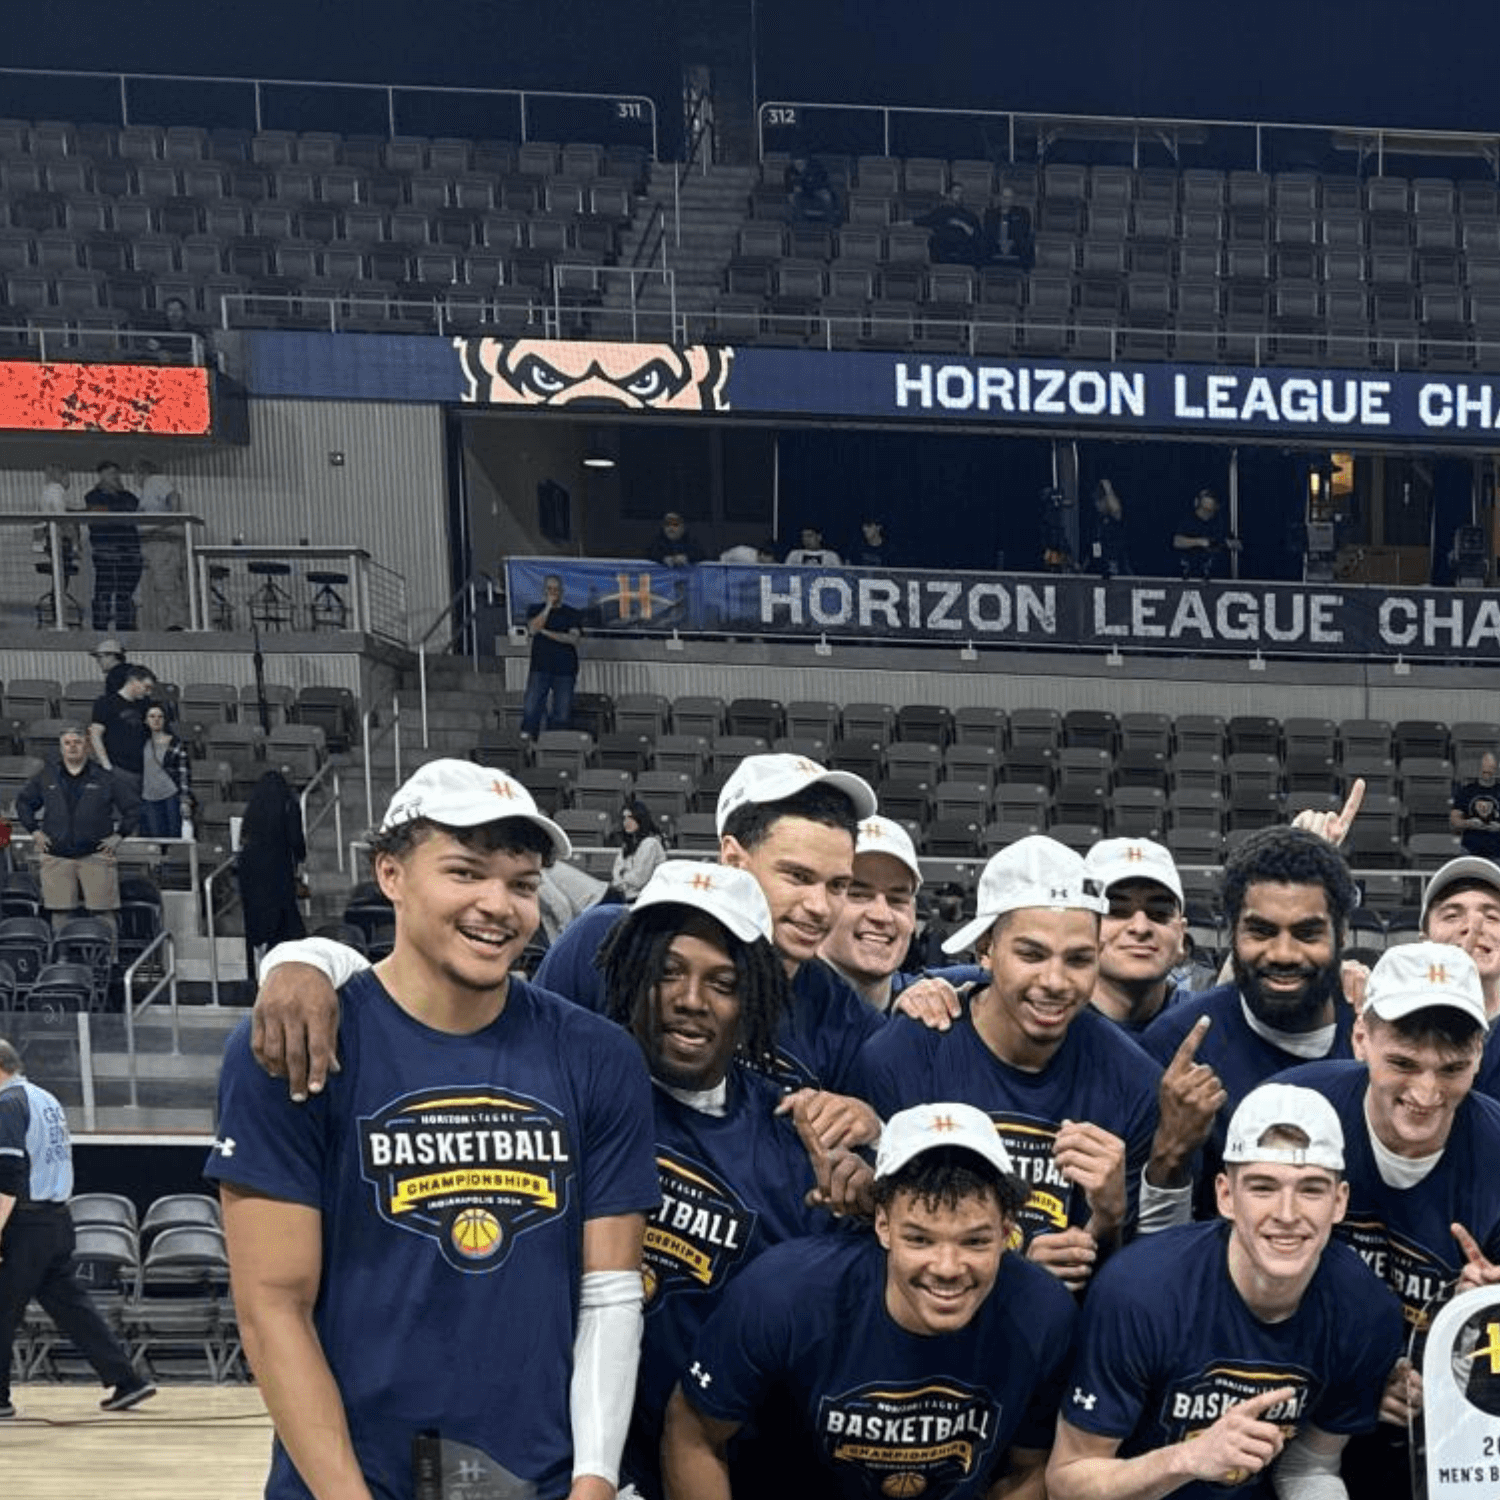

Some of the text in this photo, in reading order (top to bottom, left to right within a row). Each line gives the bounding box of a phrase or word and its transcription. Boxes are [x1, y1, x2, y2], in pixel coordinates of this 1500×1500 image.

[619, 103, 640, 118] 311
[769, 109, 796, 124] 312
[896, 364, 1145, 417] HORIZON
[1174, 374, 1391, 426] LEAGUE
[759, 574, 1057, 634] HORIZON
[1094, 586, 1345, 643] LEAGUE
[369, 1129, 569, 1166] BASKETBALL
[406, 1173, 541, 1196] CHAMPIONSHIPS
[826, 1408, 989, 1443] BASKETBALL
[1438, 1466, 1485, 1484] MEN'S
